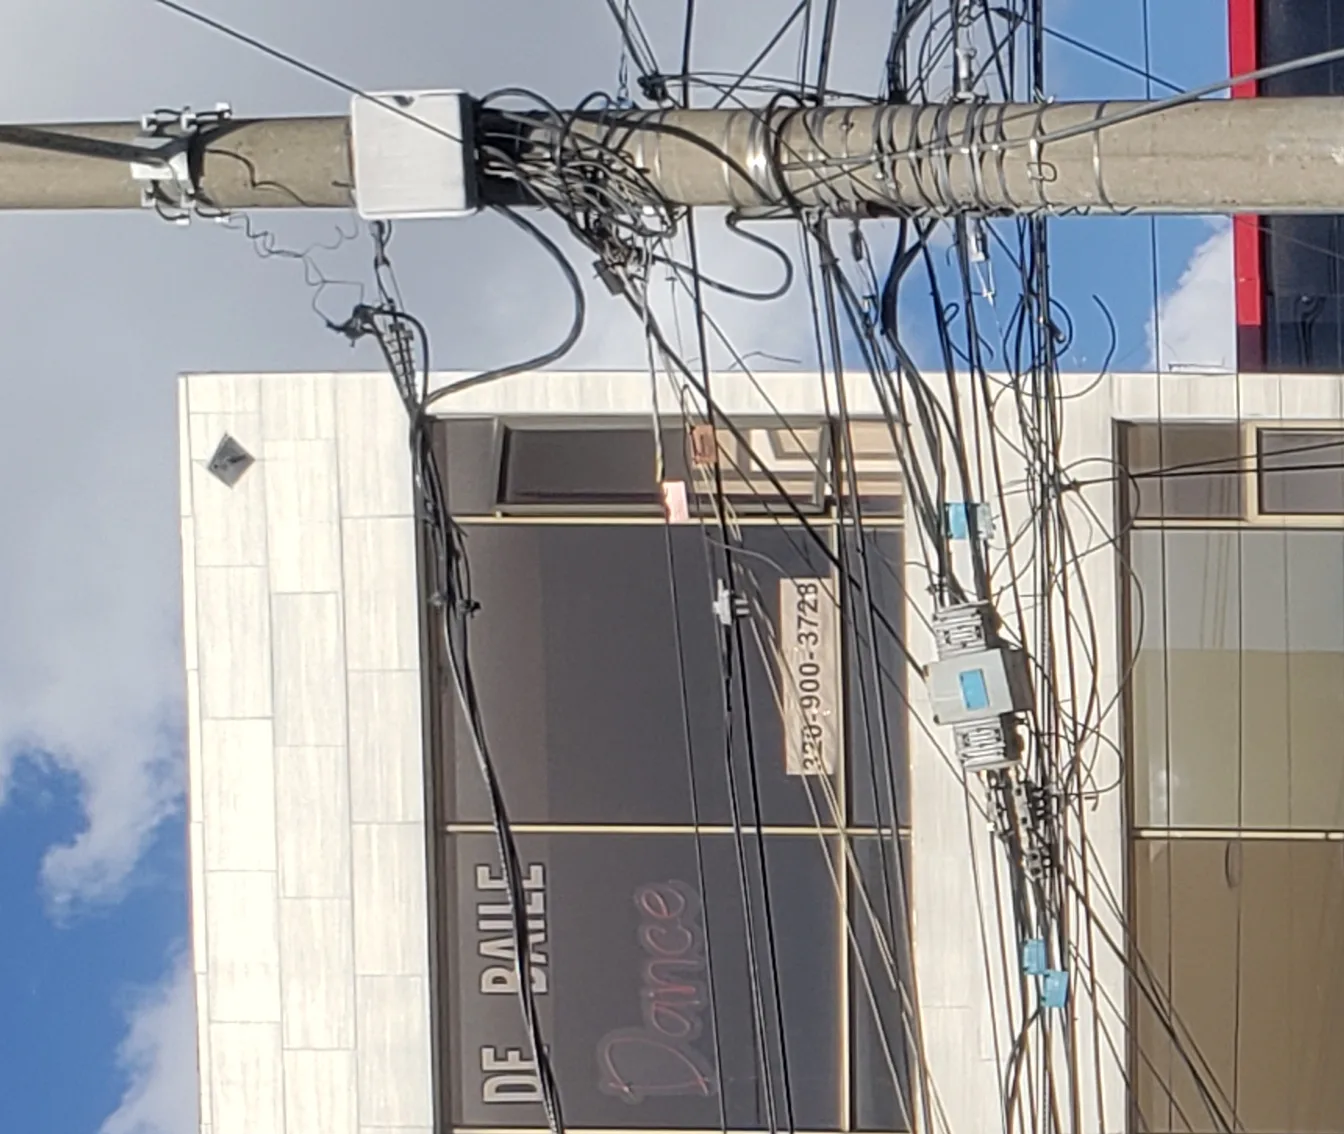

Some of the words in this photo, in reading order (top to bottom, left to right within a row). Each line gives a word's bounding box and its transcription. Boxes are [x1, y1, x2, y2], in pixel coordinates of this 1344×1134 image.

[475, 863, 549, 995] BAILE
[602, 882, 710, 1100] Dance
[481, 1046, 549, 1104] DE
